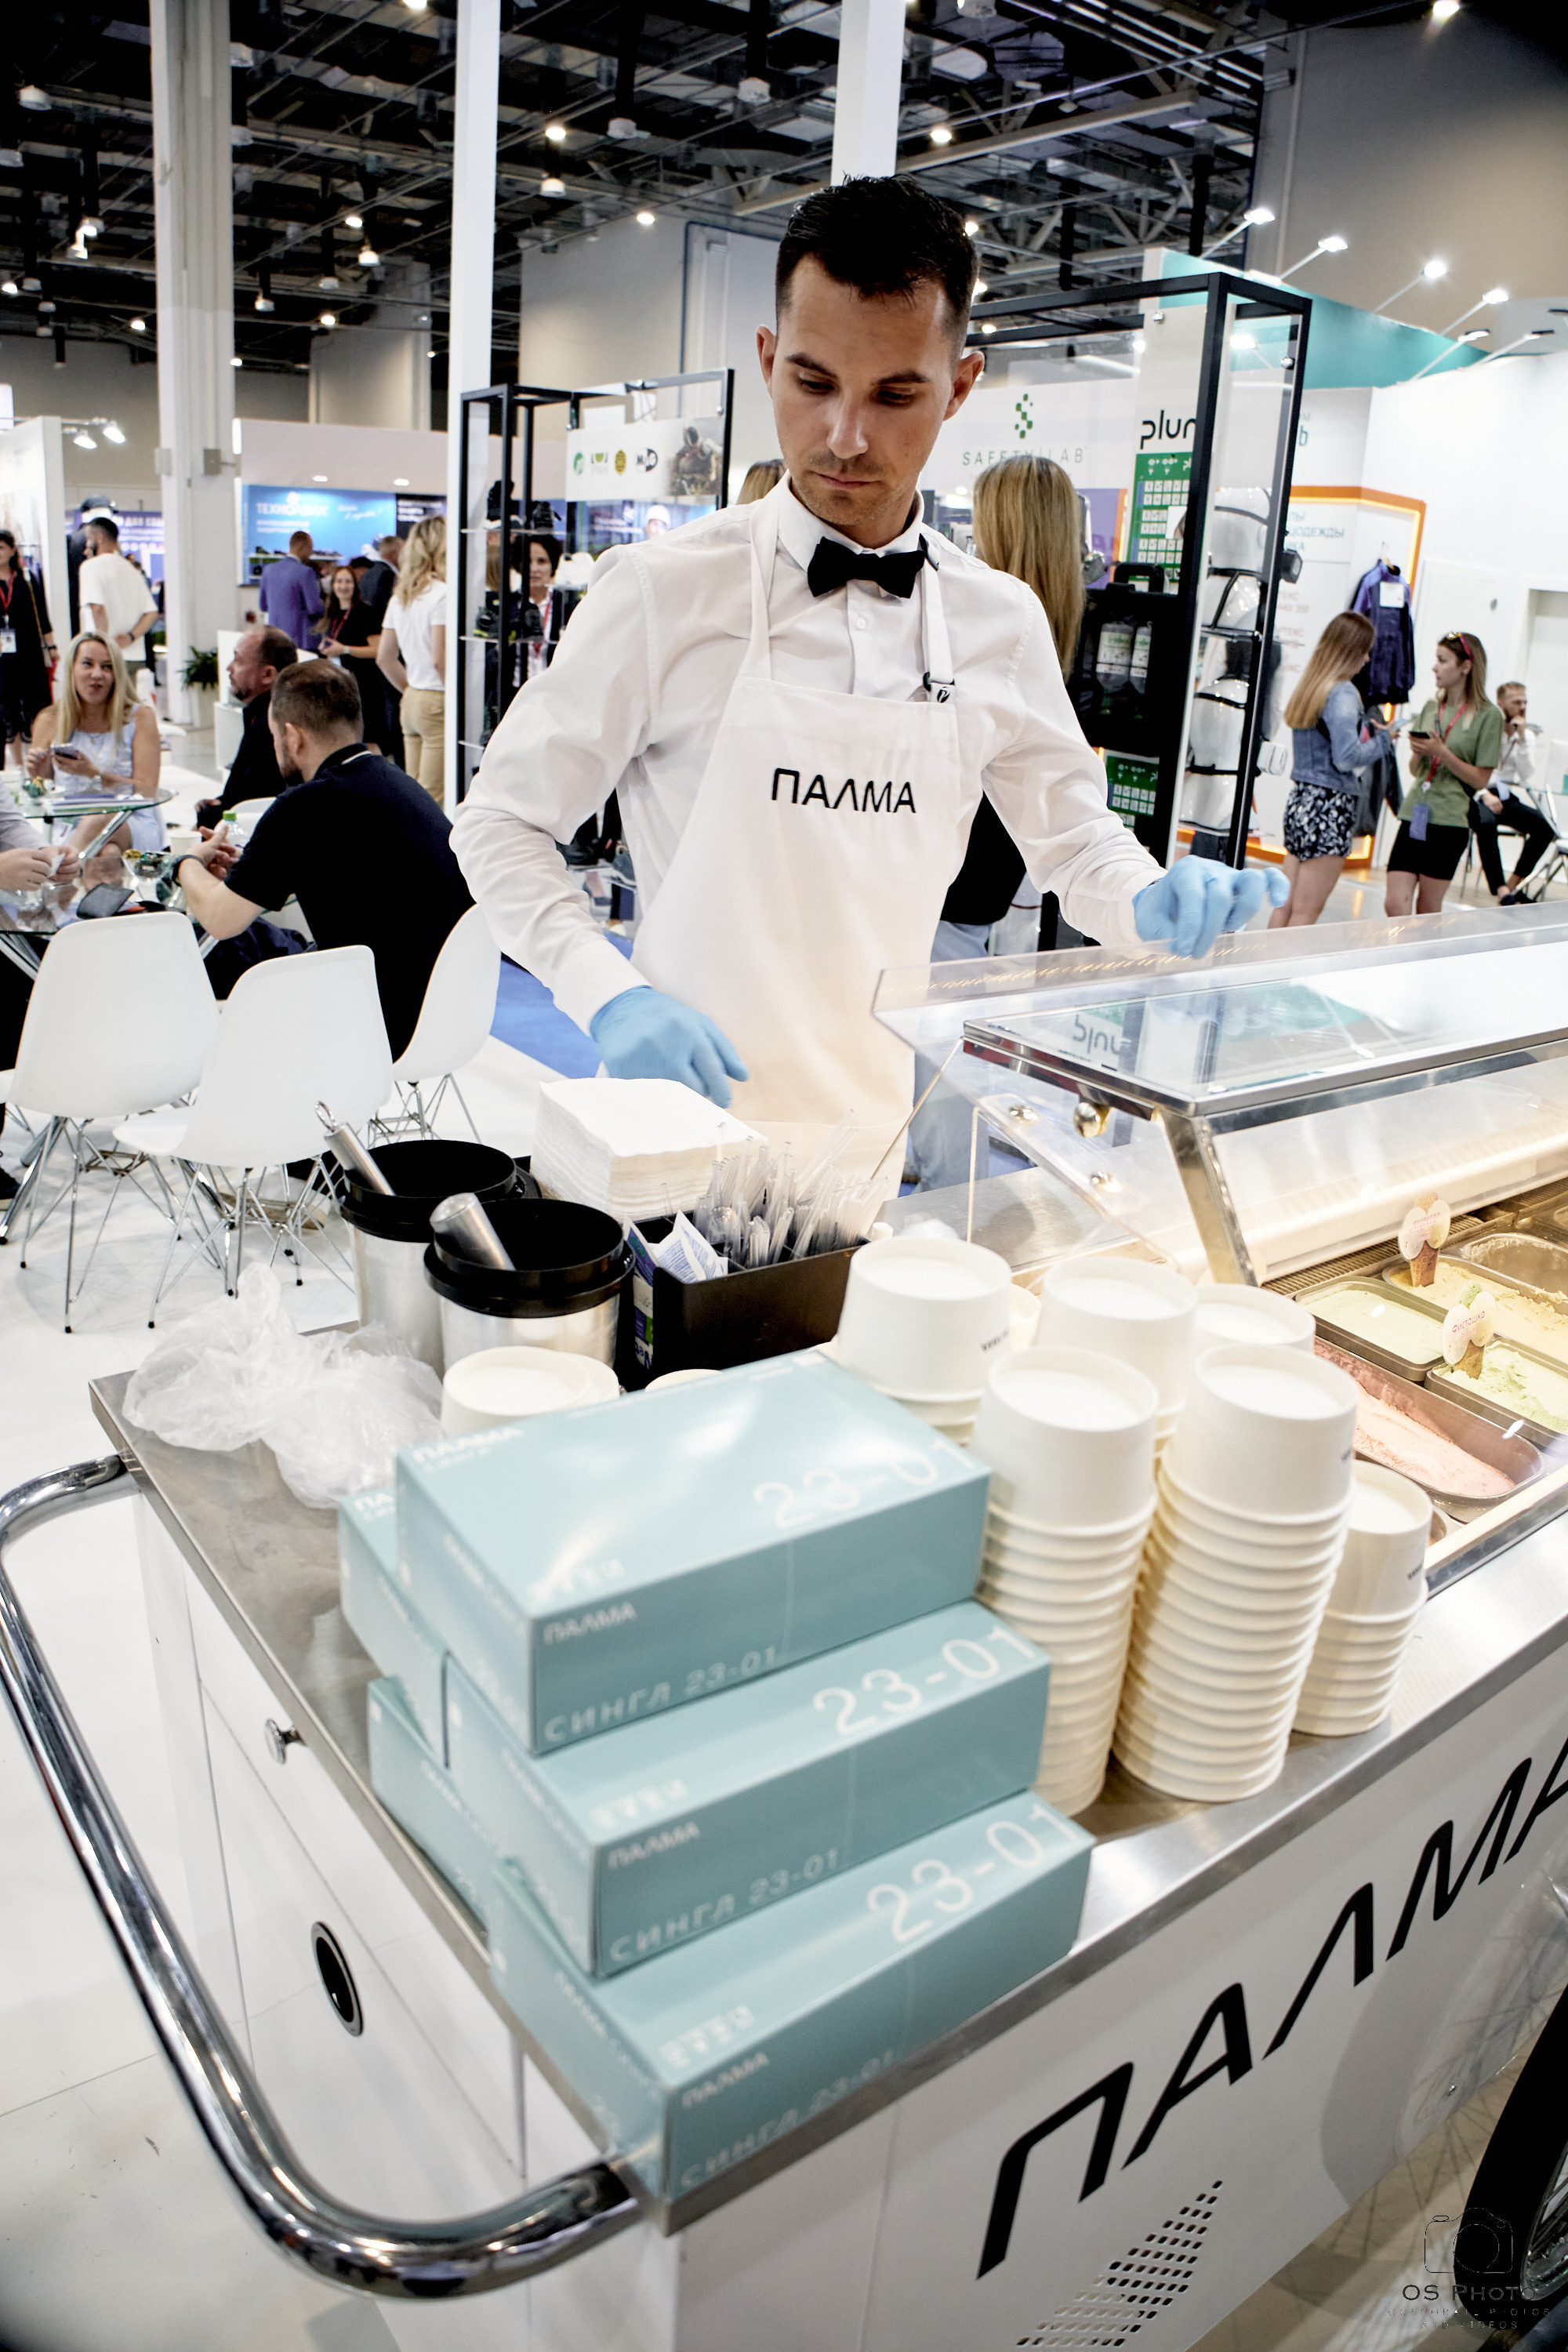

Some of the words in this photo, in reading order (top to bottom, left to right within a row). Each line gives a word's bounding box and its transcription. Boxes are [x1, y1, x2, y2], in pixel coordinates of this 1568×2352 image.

[771, 768, 916, 815] ПАЛМА
[752, 1437, 975, 1530] 23-01
[543, 1601, 638, 1646] ПАЛМА
[544, 1681, 671, 1743] СИНГЛ
[684, 1646, 776, 1697] 23-01
[813, 1624, 1036, 1736] 23-01
[607, 1820, 701, 1870] ПАЛМА
[866, 1802, 1081, 1944] 23-01
[608, 1893, 735, 1962] СИНГЛ
[748, 1847, 839, 1906] 23-01
